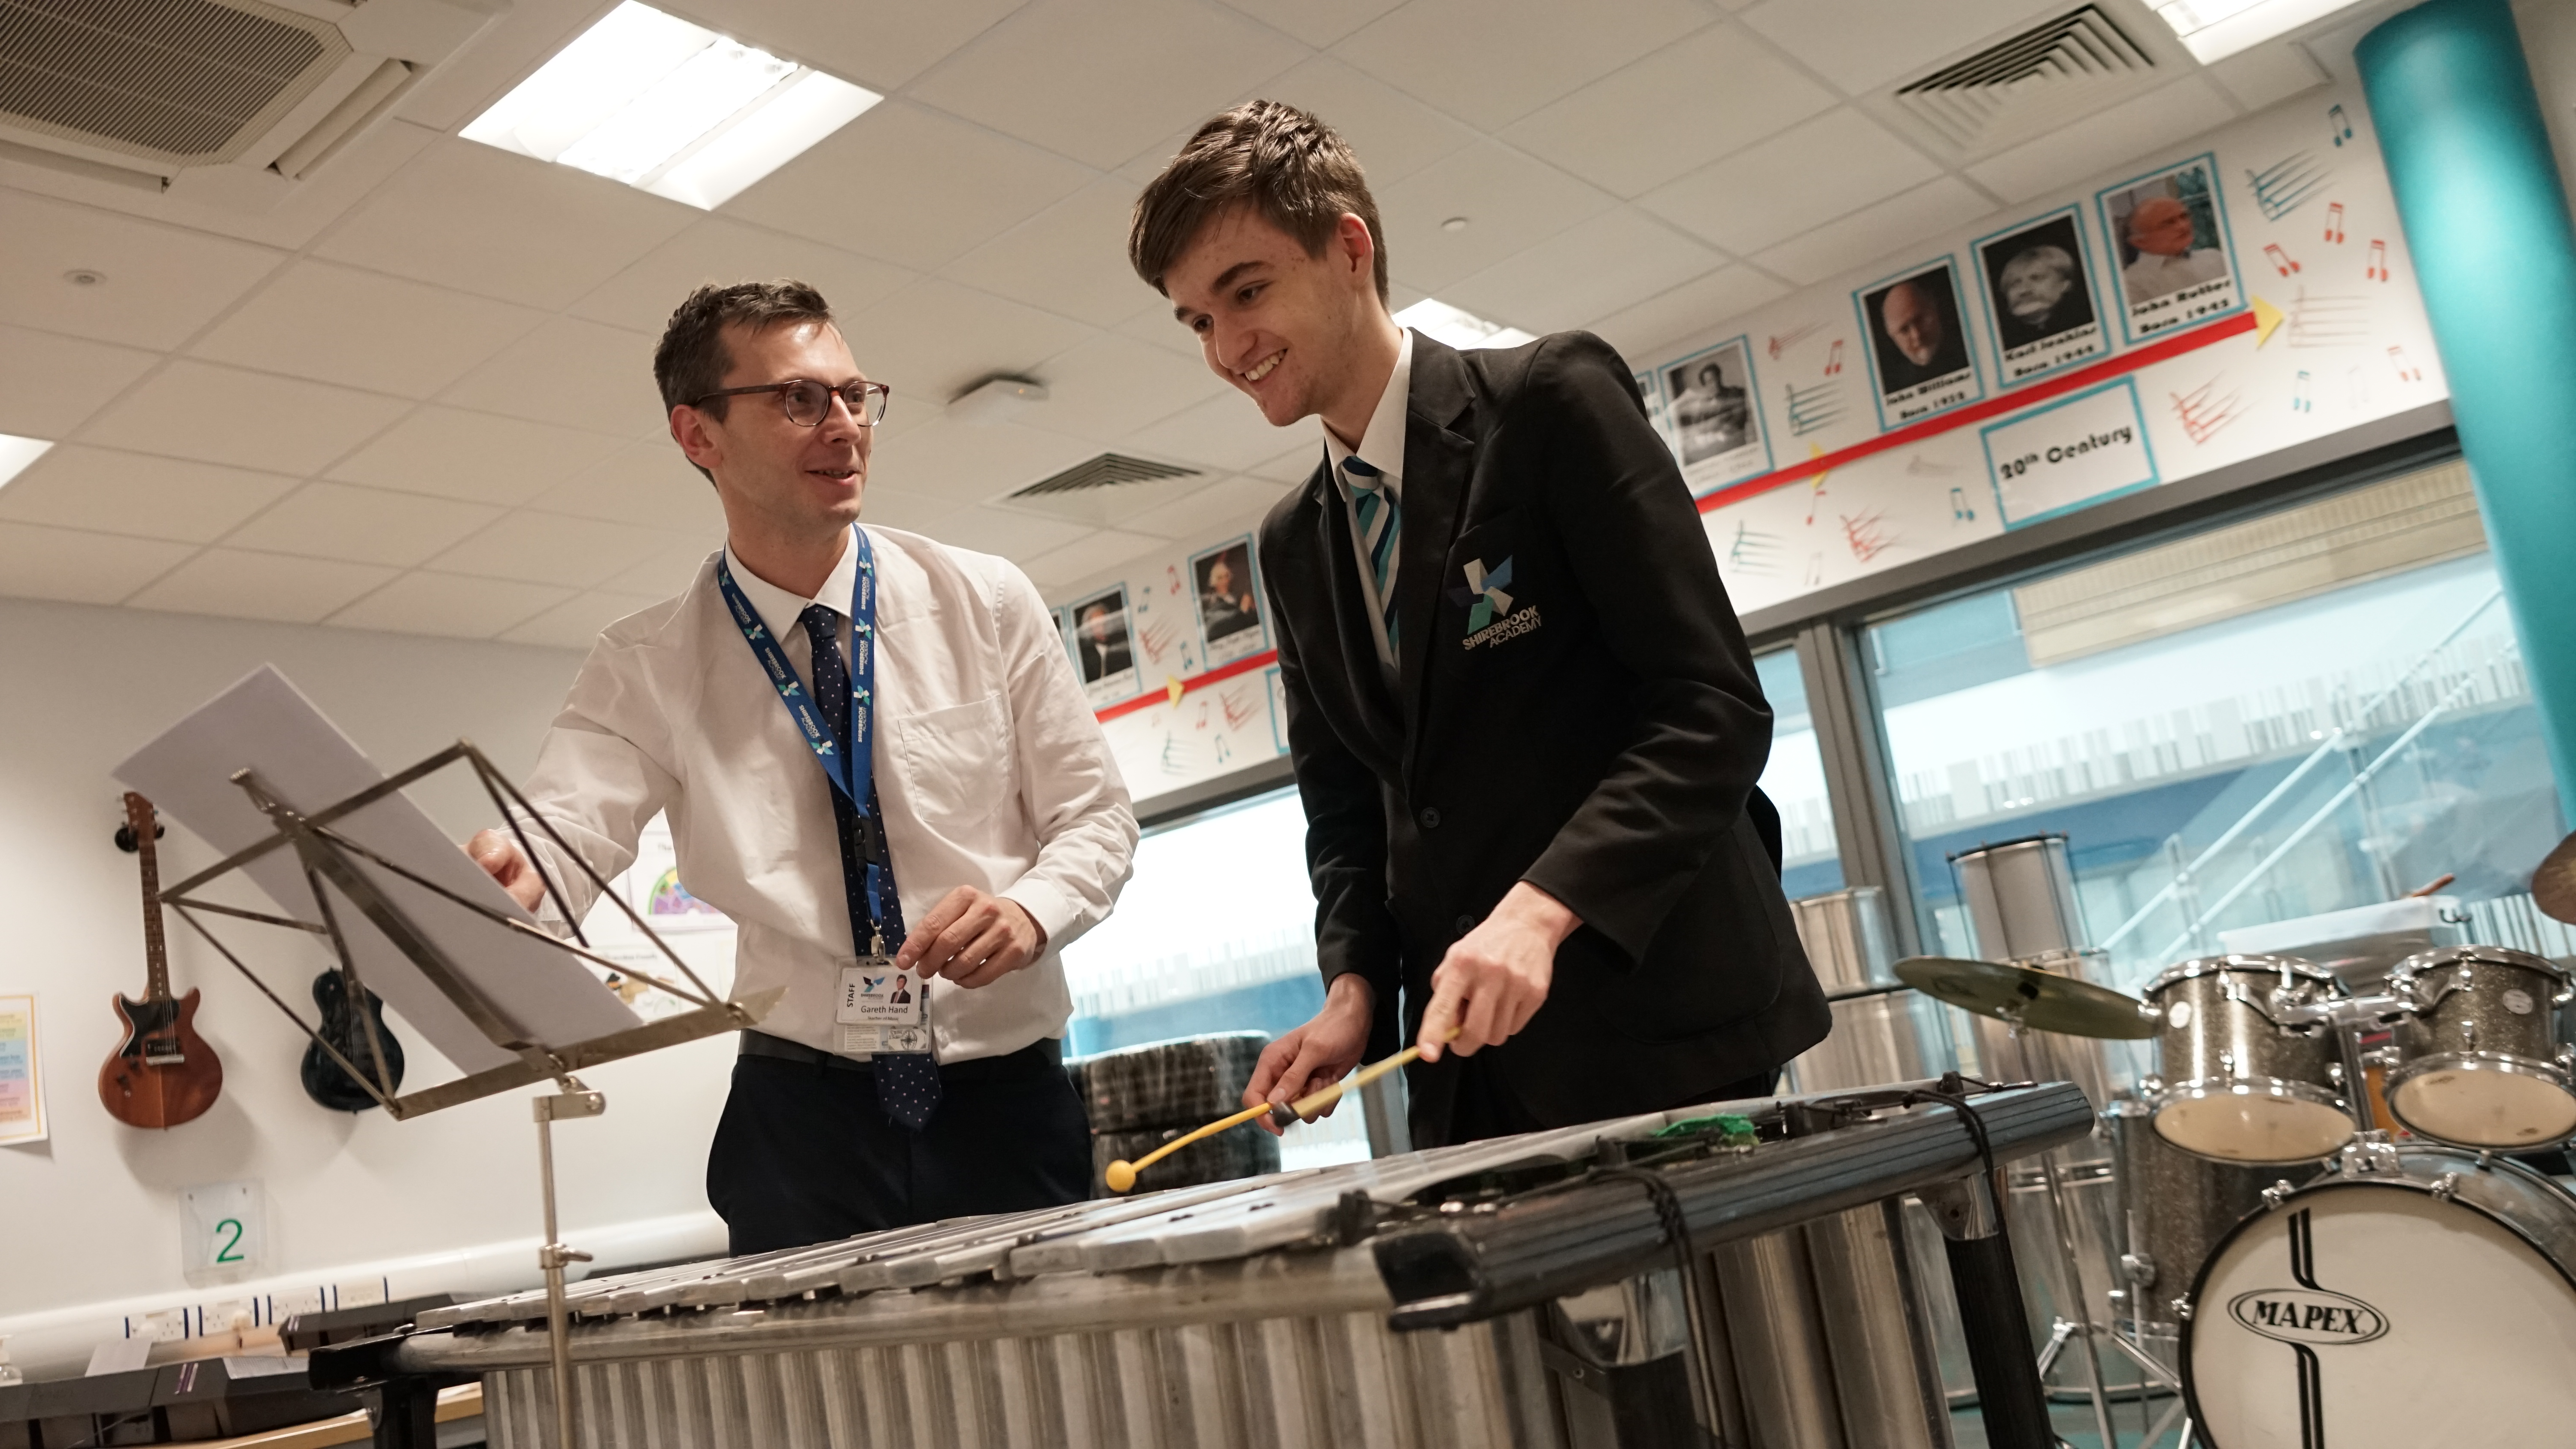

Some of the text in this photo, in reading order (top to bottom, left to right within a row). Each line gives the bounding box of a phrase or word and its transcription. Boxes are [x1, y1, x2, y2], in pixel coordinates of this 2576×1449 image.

[2132, 300, 2170, 317] John
[2000, 426, 2132, 480] 20th Century
[1462, 605, 1539, 651] SHIREBROOK
[1489, 615, 1542, 648] ACADEMY
[799, 704, 821, 738] SHIREBROOK
[847, 983, 856, 1008] STAFF
[861, 1005, 908, 1014] Gareth Hand
[216, 1218, 244, 1264] 2
[2252, 1300, 2366, 1335] MAPEX
